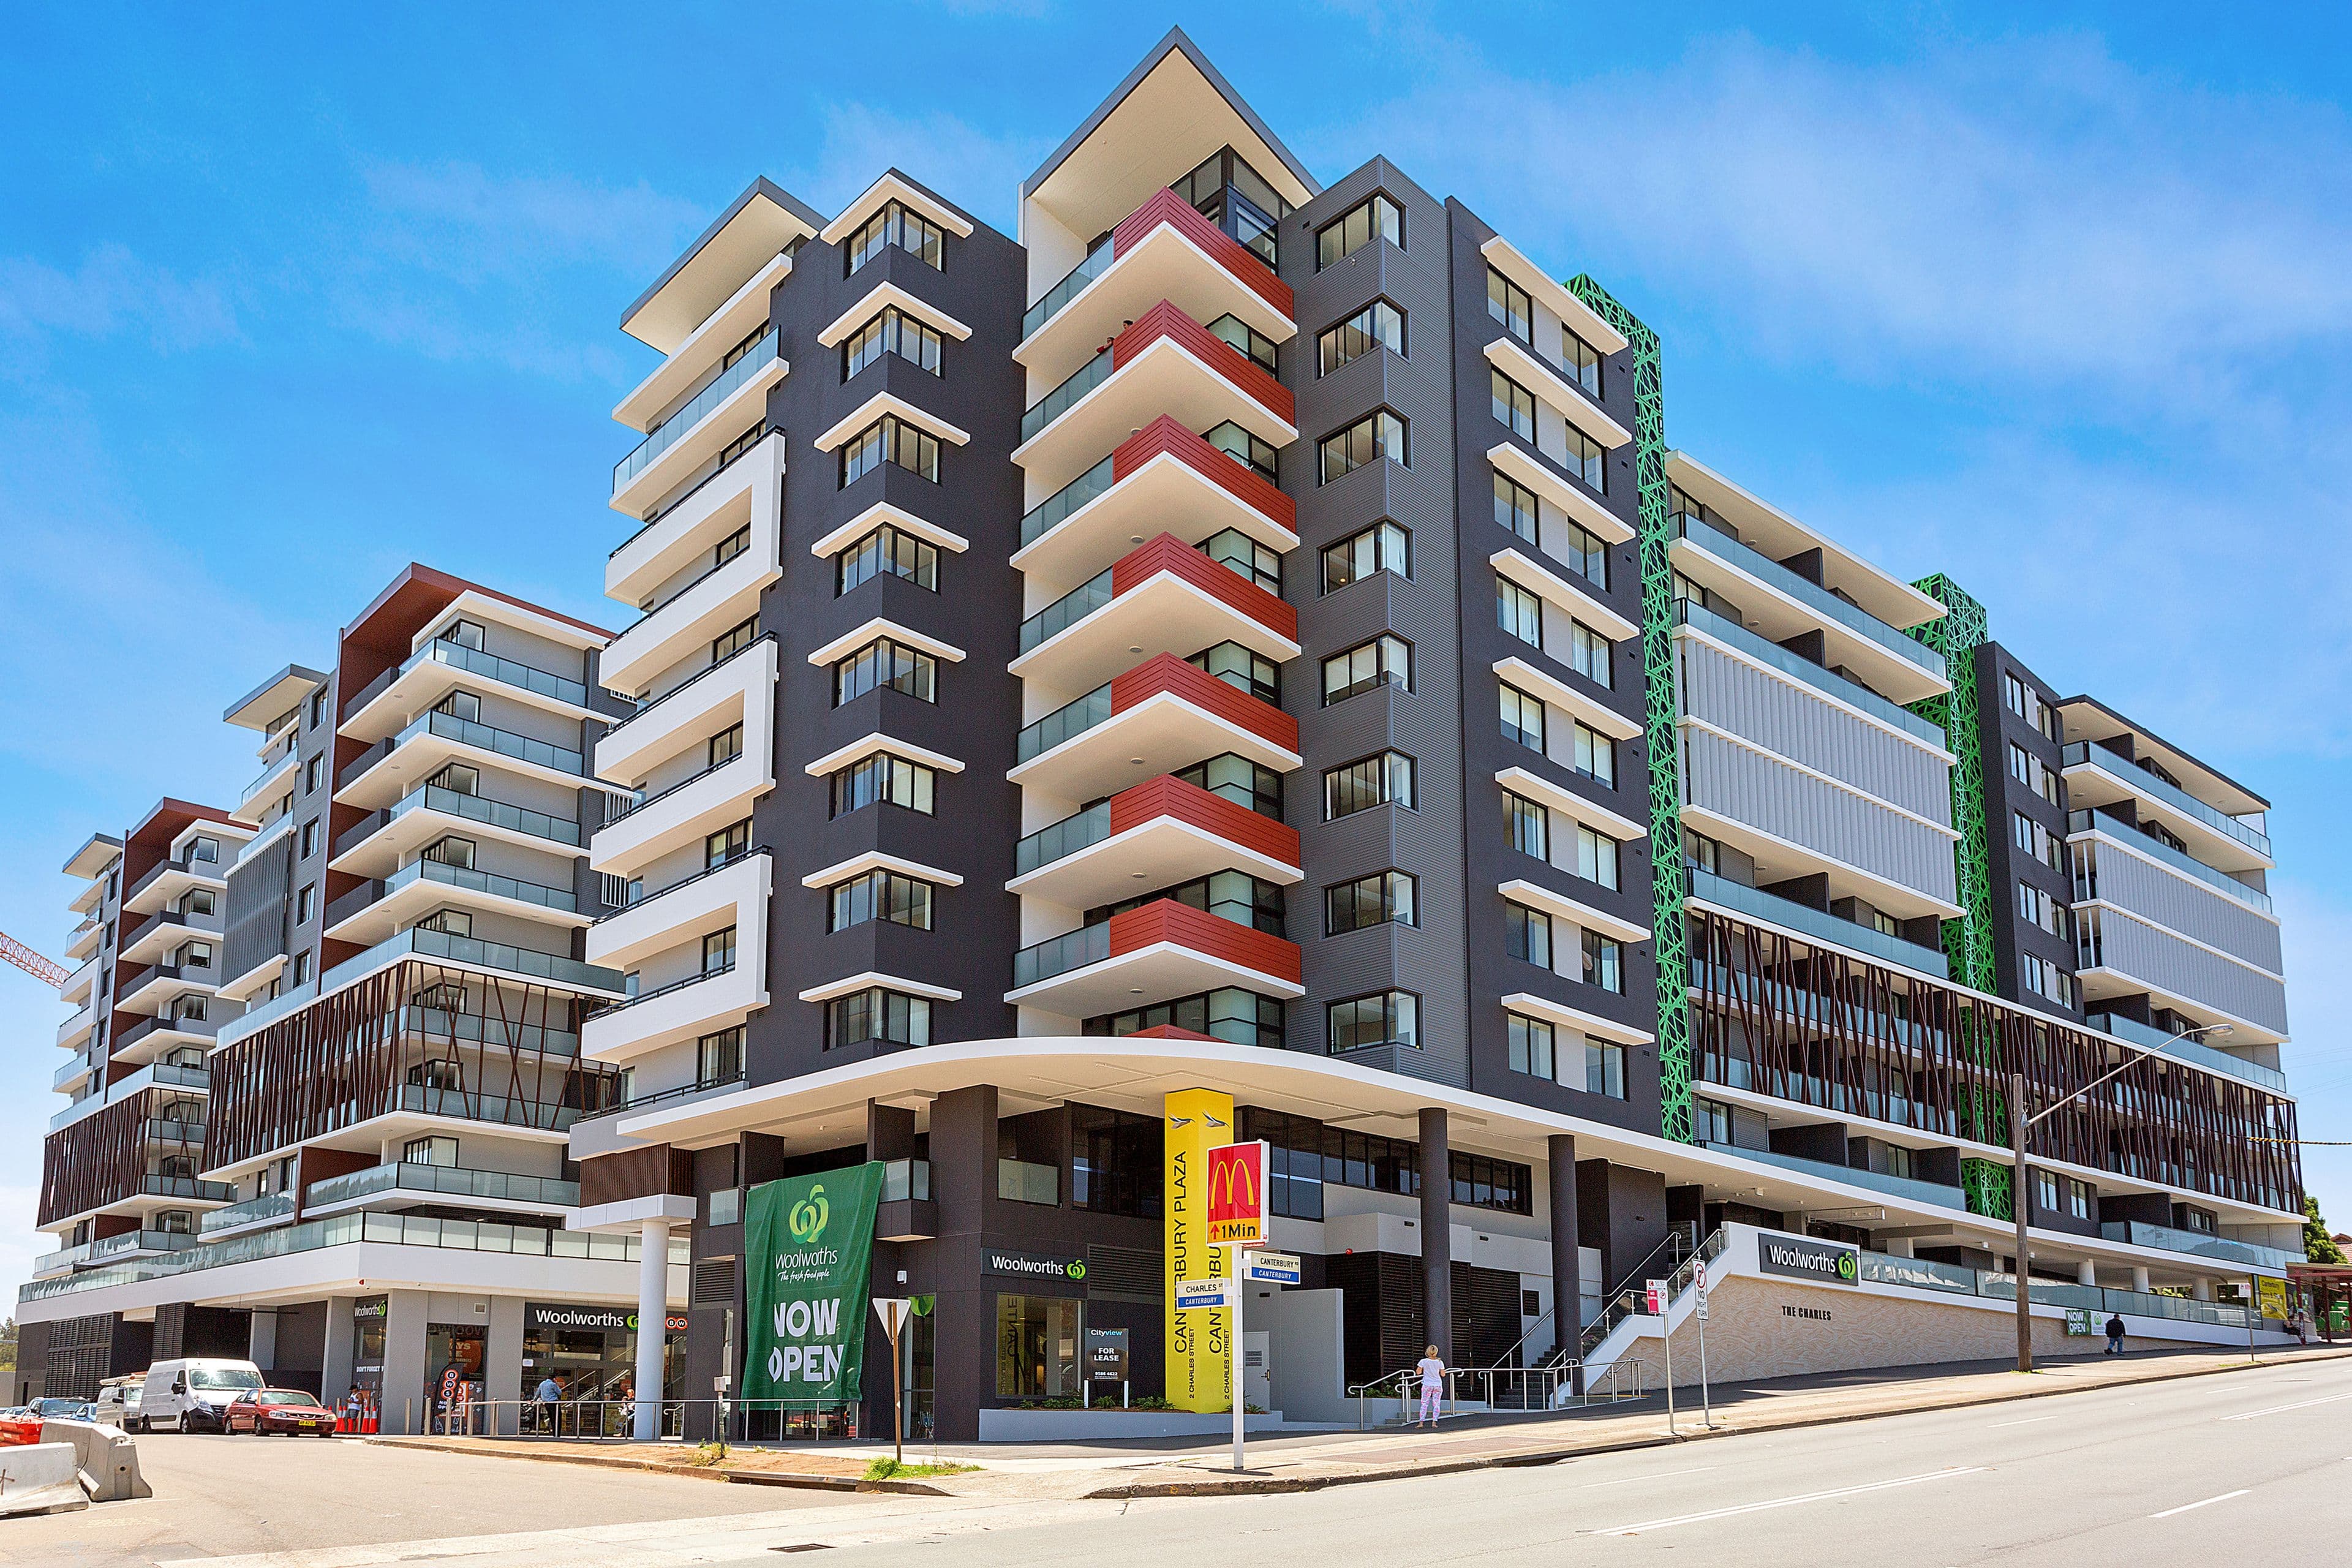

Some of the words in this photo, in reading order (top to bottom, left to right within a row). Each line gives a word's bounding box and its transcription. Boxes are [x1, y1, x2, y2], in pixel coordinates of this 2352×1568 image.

[1174, 1150, 1186, 1212] PLAZA
[775, 1246, 838, 1269] Woolwoths
[991, 1255, 1064, 1275] Woolworths
[1260, 1257, 1294, 1268] CANTERBURY
[1769, 1244, 1836, 1273] Woolworths
[777, 1270, 789, 1282] The
[789, 1270, 804, 1284] fresh
[1259, 1270, 1292, 1279] CANTERBURY
[1174, 1218, 1187, 1354] CANRBURY
[1186, 1284, 1217, 1293] CHARLES
[1185, 1297, 1217, 1305] CANTERBURY
[1697, 1290, 1705, 1300] NO
[535, 1310, 624, 1327] Woolworths
[774, 1298, 840, 1338] NOW
[1782, 1305, 1796, 1317] THE
[1798, 1307, 1831, 1321] CHARLES
[2067, 1311, 2084, 1322] NOW
[2069, 1322, 2086, 1333] OPEN
[768, 1344, 845, 1383] OPEN
